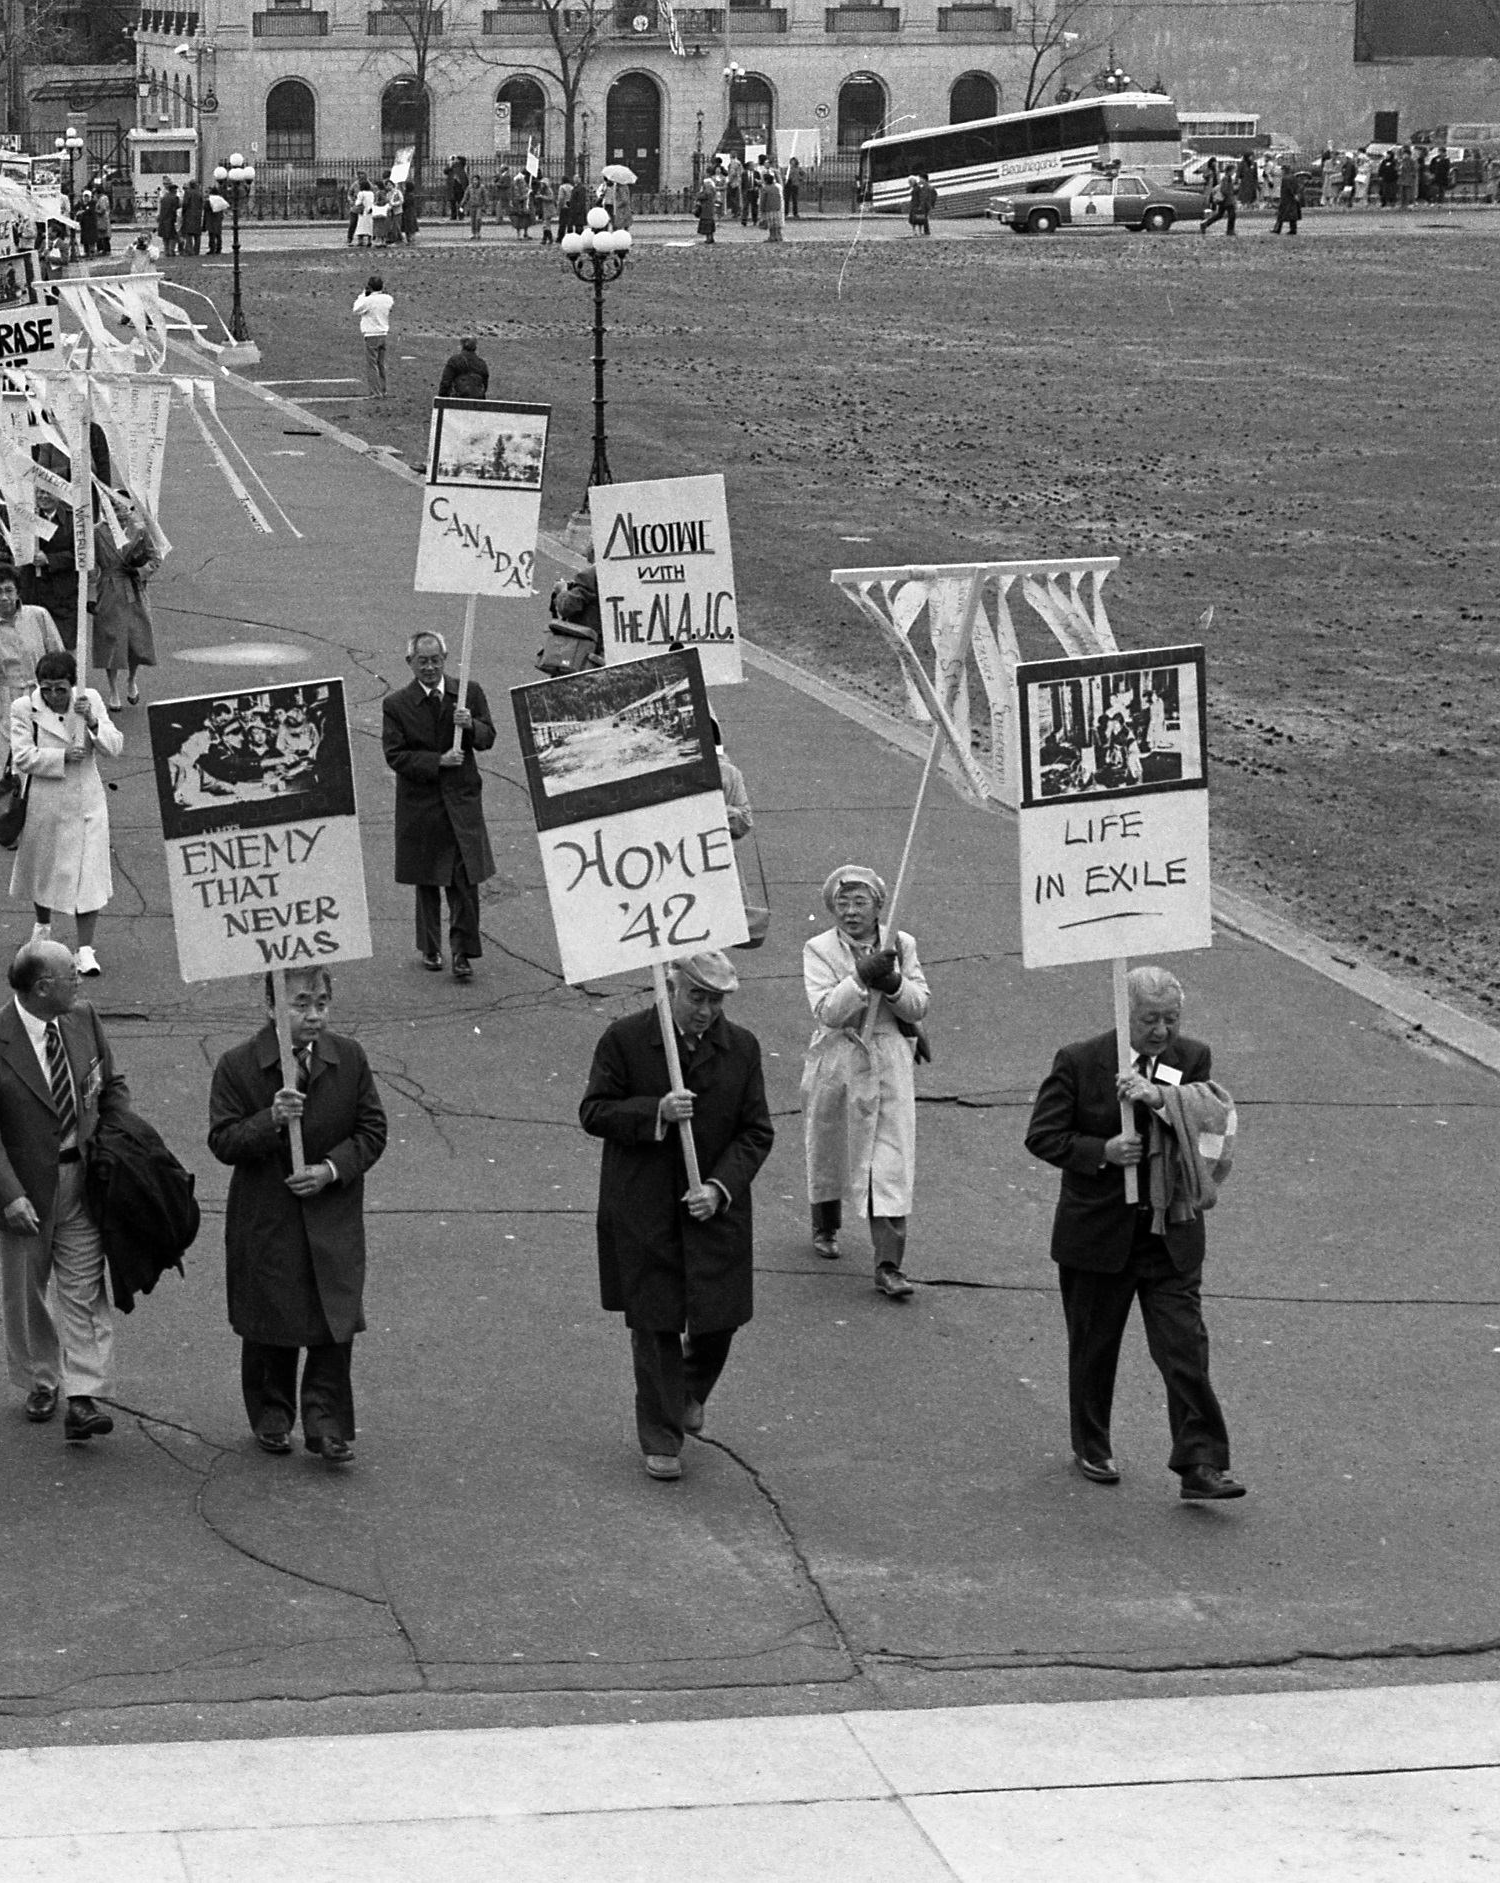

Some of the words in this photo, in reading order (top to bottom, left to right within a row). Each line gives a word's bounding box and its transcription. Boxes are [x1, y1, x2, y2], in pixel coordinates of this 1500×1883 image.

[76, 504, 90, 568] WATERLOO
[429, 497, 534, 589] CANADA?
[638, 564, 684, 580] WITH
[606, 596, 645, 643] THE
[647, 592, 734, 642] N.A.J.C.
[180, 826, 326, 876] ENEMY
[1064, 811, 1143, 845] LIFE
[554, 827, 732, 892] HOME
[1036, 873, 1064, 904] IN
[1086, 858, 1187, 895] EXILE
[193, 873, 280, 908] THAT
[223, 896, 339, 937] NEVER
[619, 893, 710, 948] '42
[256, 931, 339, 963] WAS
